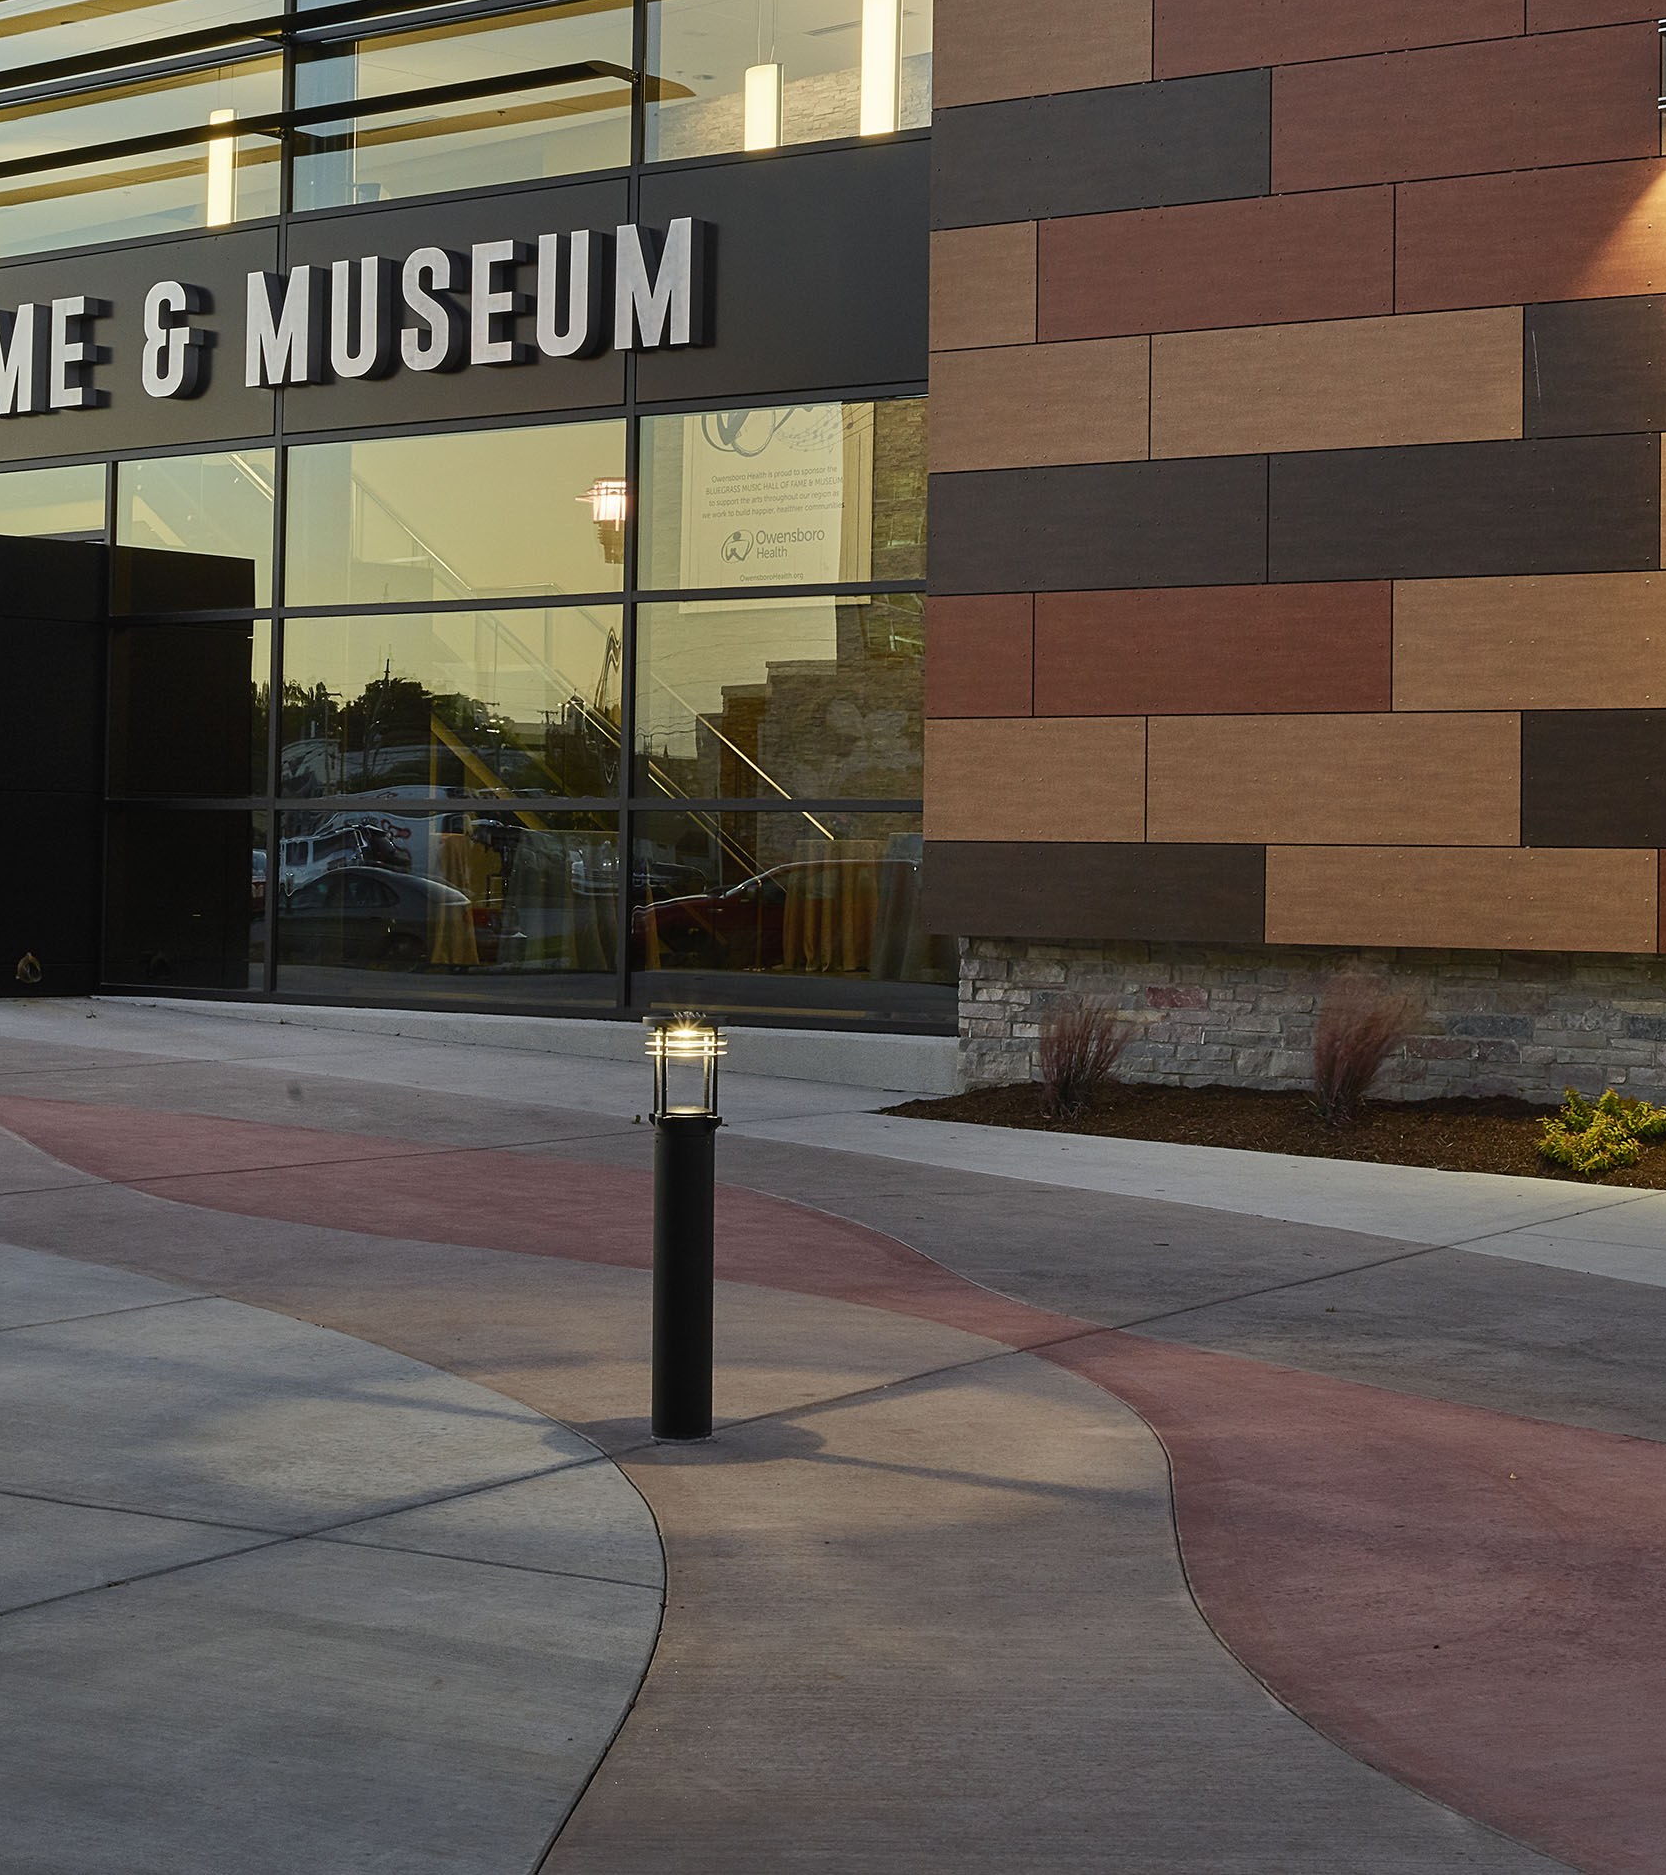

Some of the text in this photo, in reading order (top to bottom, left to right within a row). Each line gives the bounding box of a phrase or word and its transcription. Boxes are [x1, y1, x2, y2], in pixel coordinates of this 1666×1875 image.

[143, 280, 199, 399] &
[244, 216, 694, 389] MUSEUM
[711, 474, 746, 483] Owensboro
[747, 471, 767, 480] Health
[774, 468, 793, 479] proud
[794, 468, 801, 476] to
[801, 467, 826, 478] sponsor
[827, 465, 838, 473] the
[705, 484, 741, 495] BLUEGRASS
[741, 483, 762, 493] MUSIC
[763, 481, 779, 490] HALL
[780, 480, 790, 489] OF
[791, 478, 808, 488] FAME
[814, 476, 845, 486] MUSEUM
[708, 499, 716, 507] to
[716, 497, 740, 507] support
[740, 496, 751, 505] the
[751, 495, 763, 504] arts
[763, 492, 799, 503] throughout
[812, 490, 832, 501] region
[712, 509, 727, 518] work
[727, 509, 735, 517] to
[735, 507, 751, 516] build
[776, 504, 804, 513] healthier
[755, 527, 825, 545] Owensboro
[756, 546, 788, 559] Health
[739, 572, 804, 583] OwensboroHealth.org
